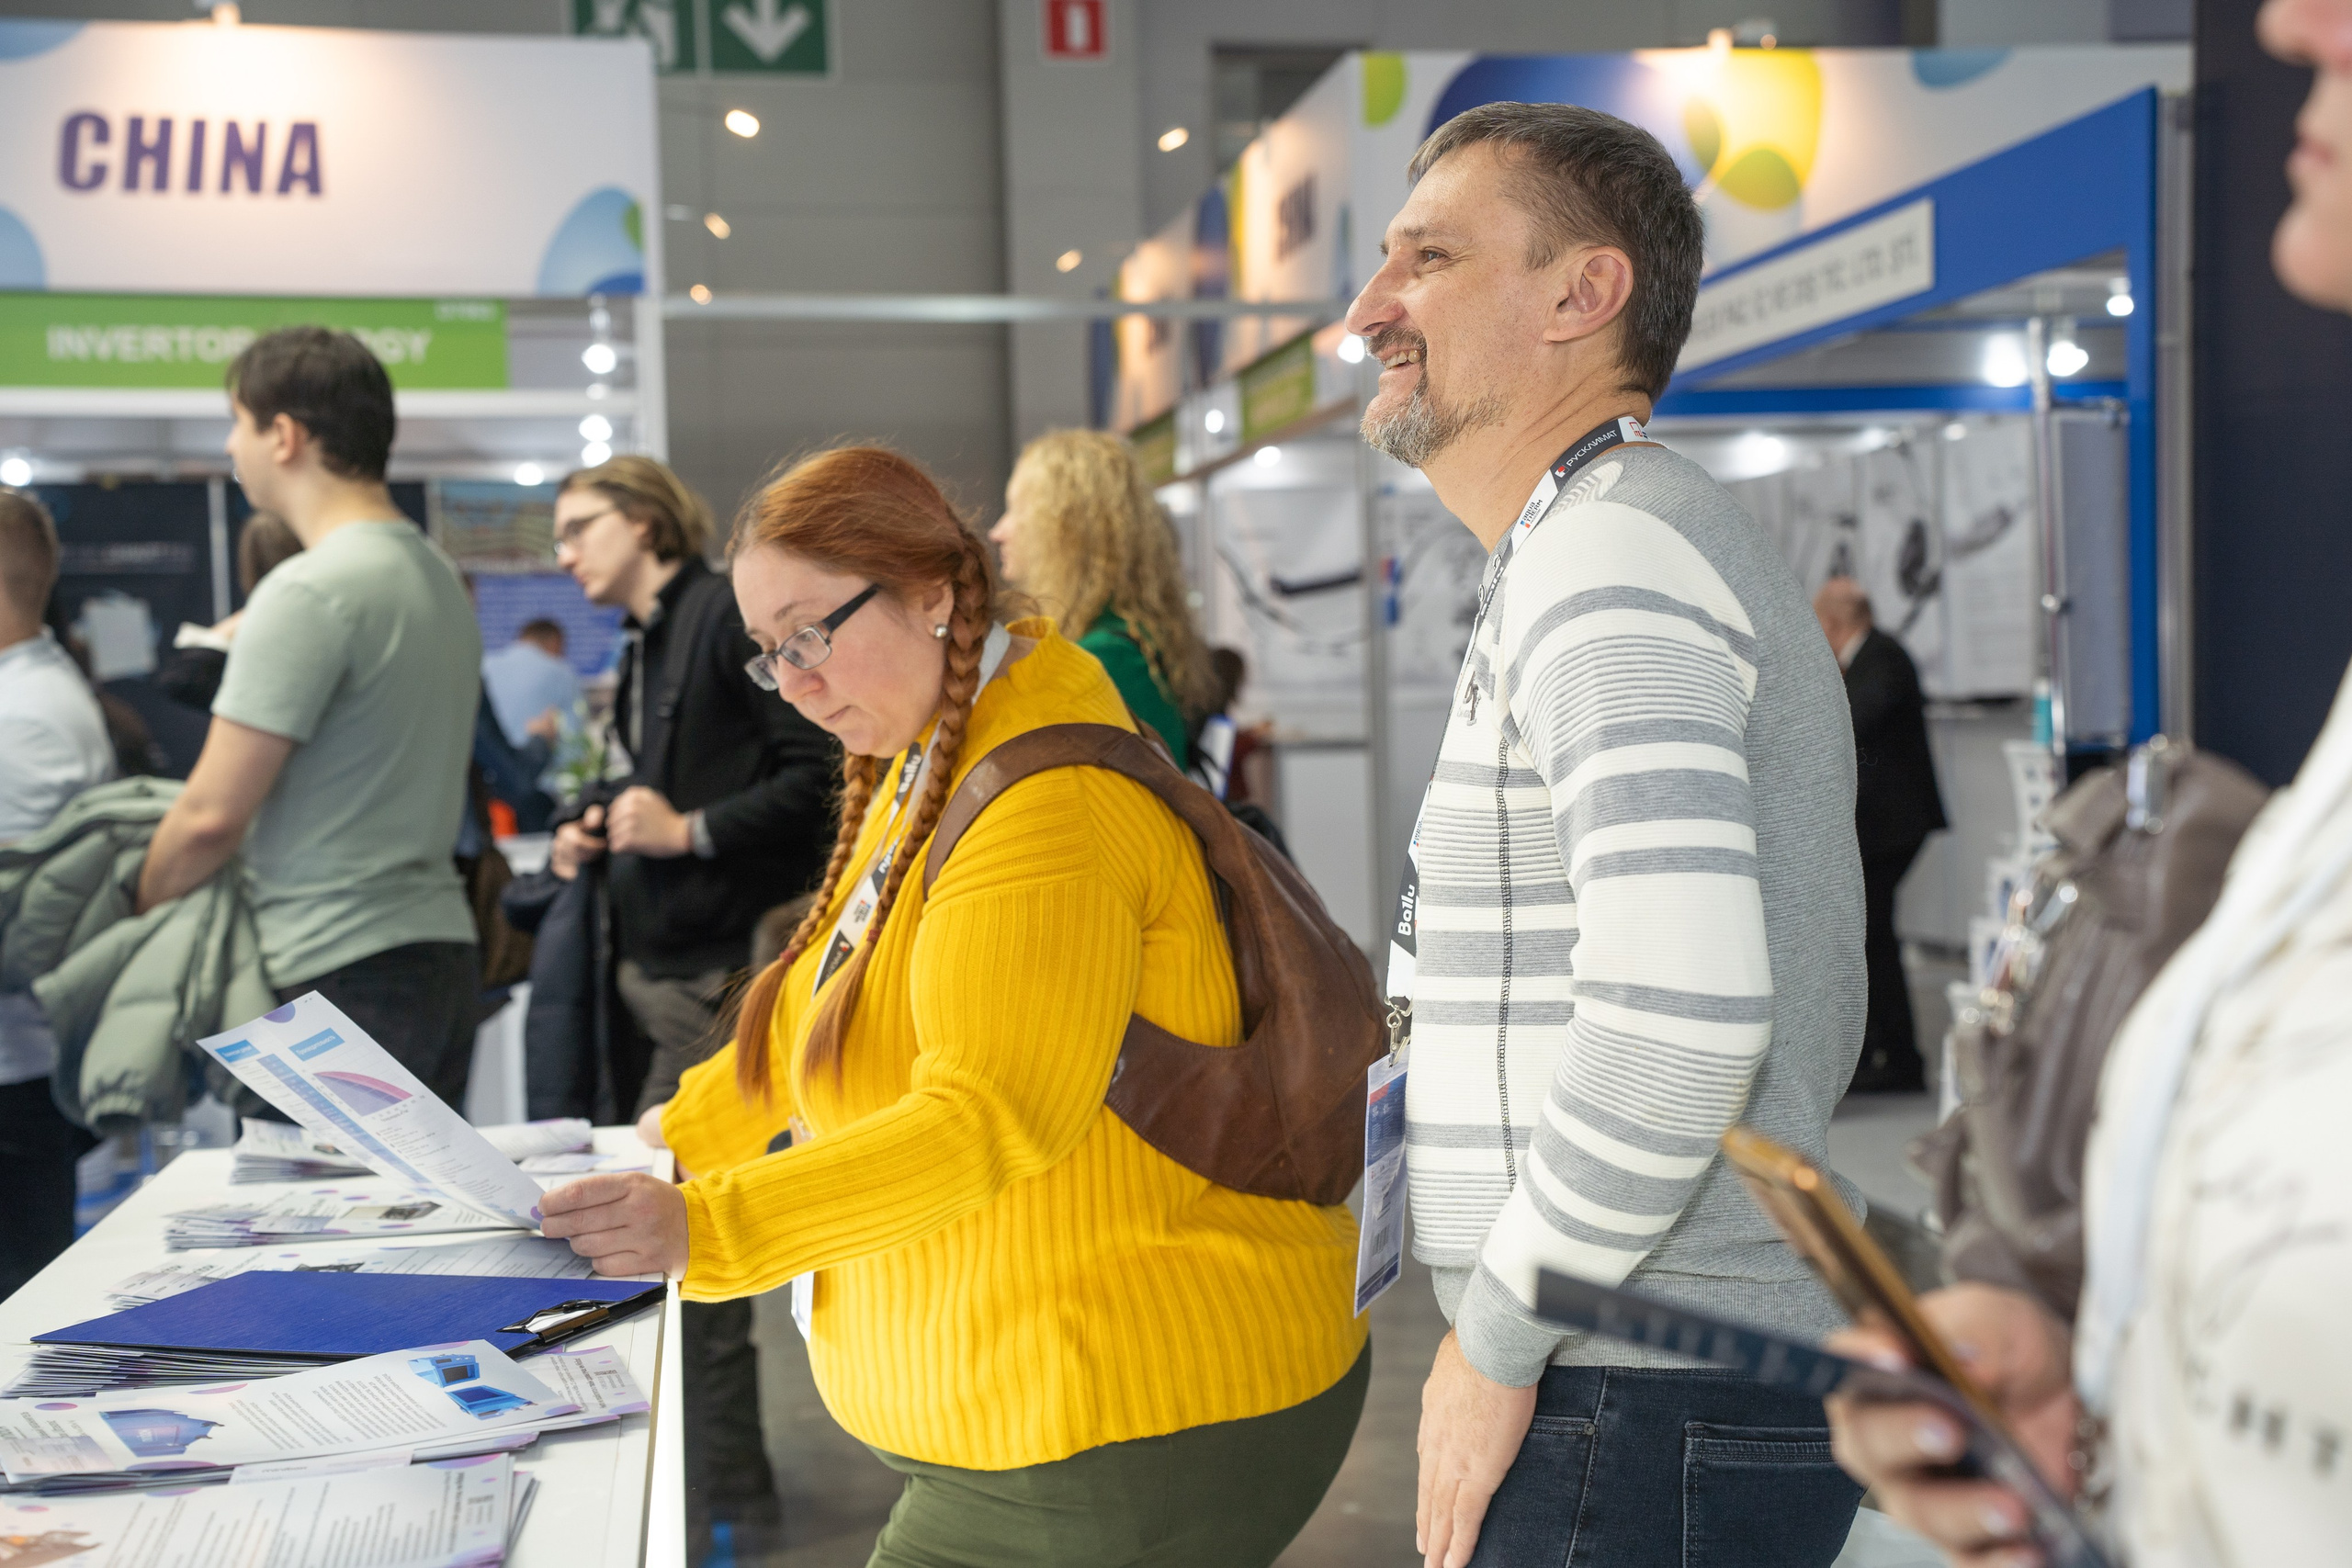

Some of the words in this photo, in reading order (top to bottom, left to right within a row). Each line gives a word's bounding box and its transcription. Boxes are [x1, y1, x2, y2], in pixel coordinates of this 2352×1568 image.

[59, 112, 322, 196] CHINA
[1566, 429, 1618, 467] РУСКЛИМАТ
[1526, 499, 1544, 523] THERM
[1397, 884, 1416, 936] Ballu
